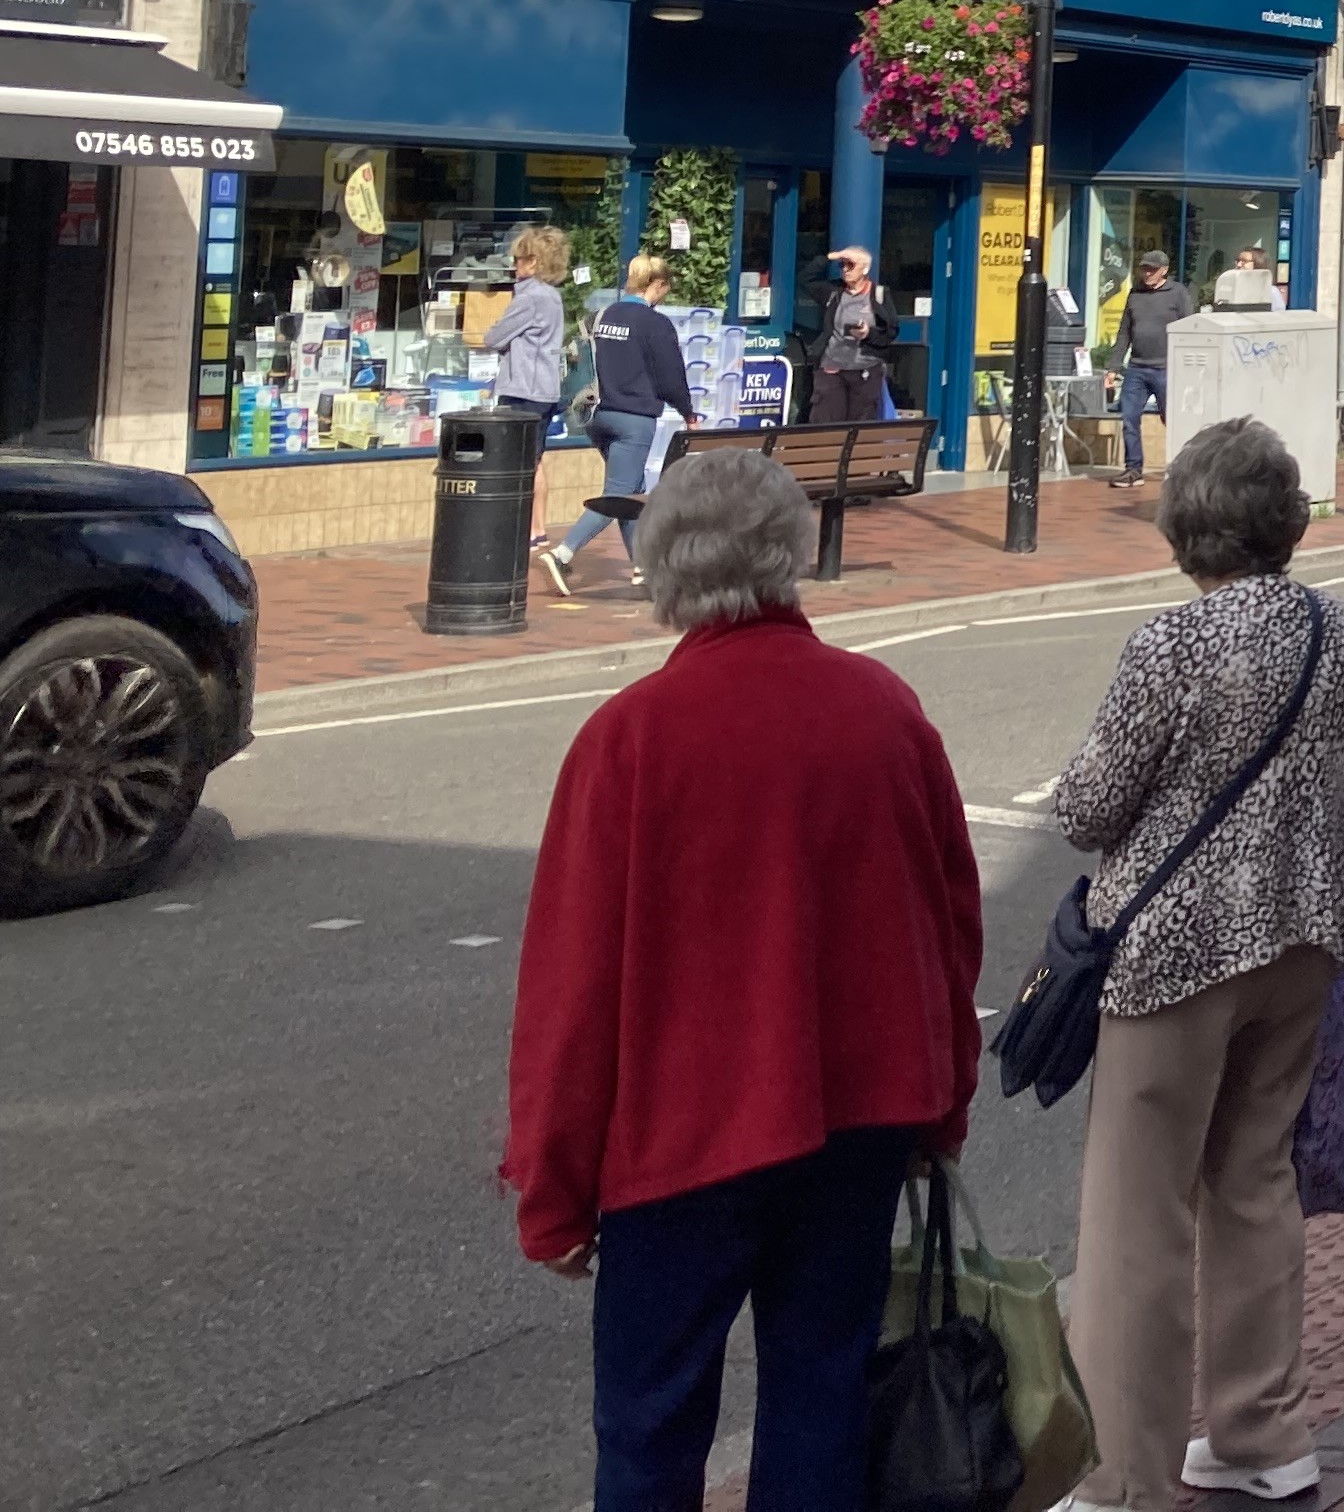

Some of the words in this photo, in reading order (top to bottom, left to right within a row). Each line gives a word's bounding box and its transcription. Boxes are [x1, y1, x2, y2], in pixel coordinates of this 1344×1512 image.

[1261, 9, 1323, 30] robertdyas.co.uk
[75, 131, 154, 156] 07546
[160, 135, 205, 159] 855
[210, 138, 256, 161] 023
[981, 232, 1023, 249] GARD
[980, 254, 1023, 267] CLEARA
[759, 335, 781, 350] Dyas
[202, 368, 225, 379] Free
[746, 373, 771, 388] KEY
[739, 387, 782, 403] UTTING
